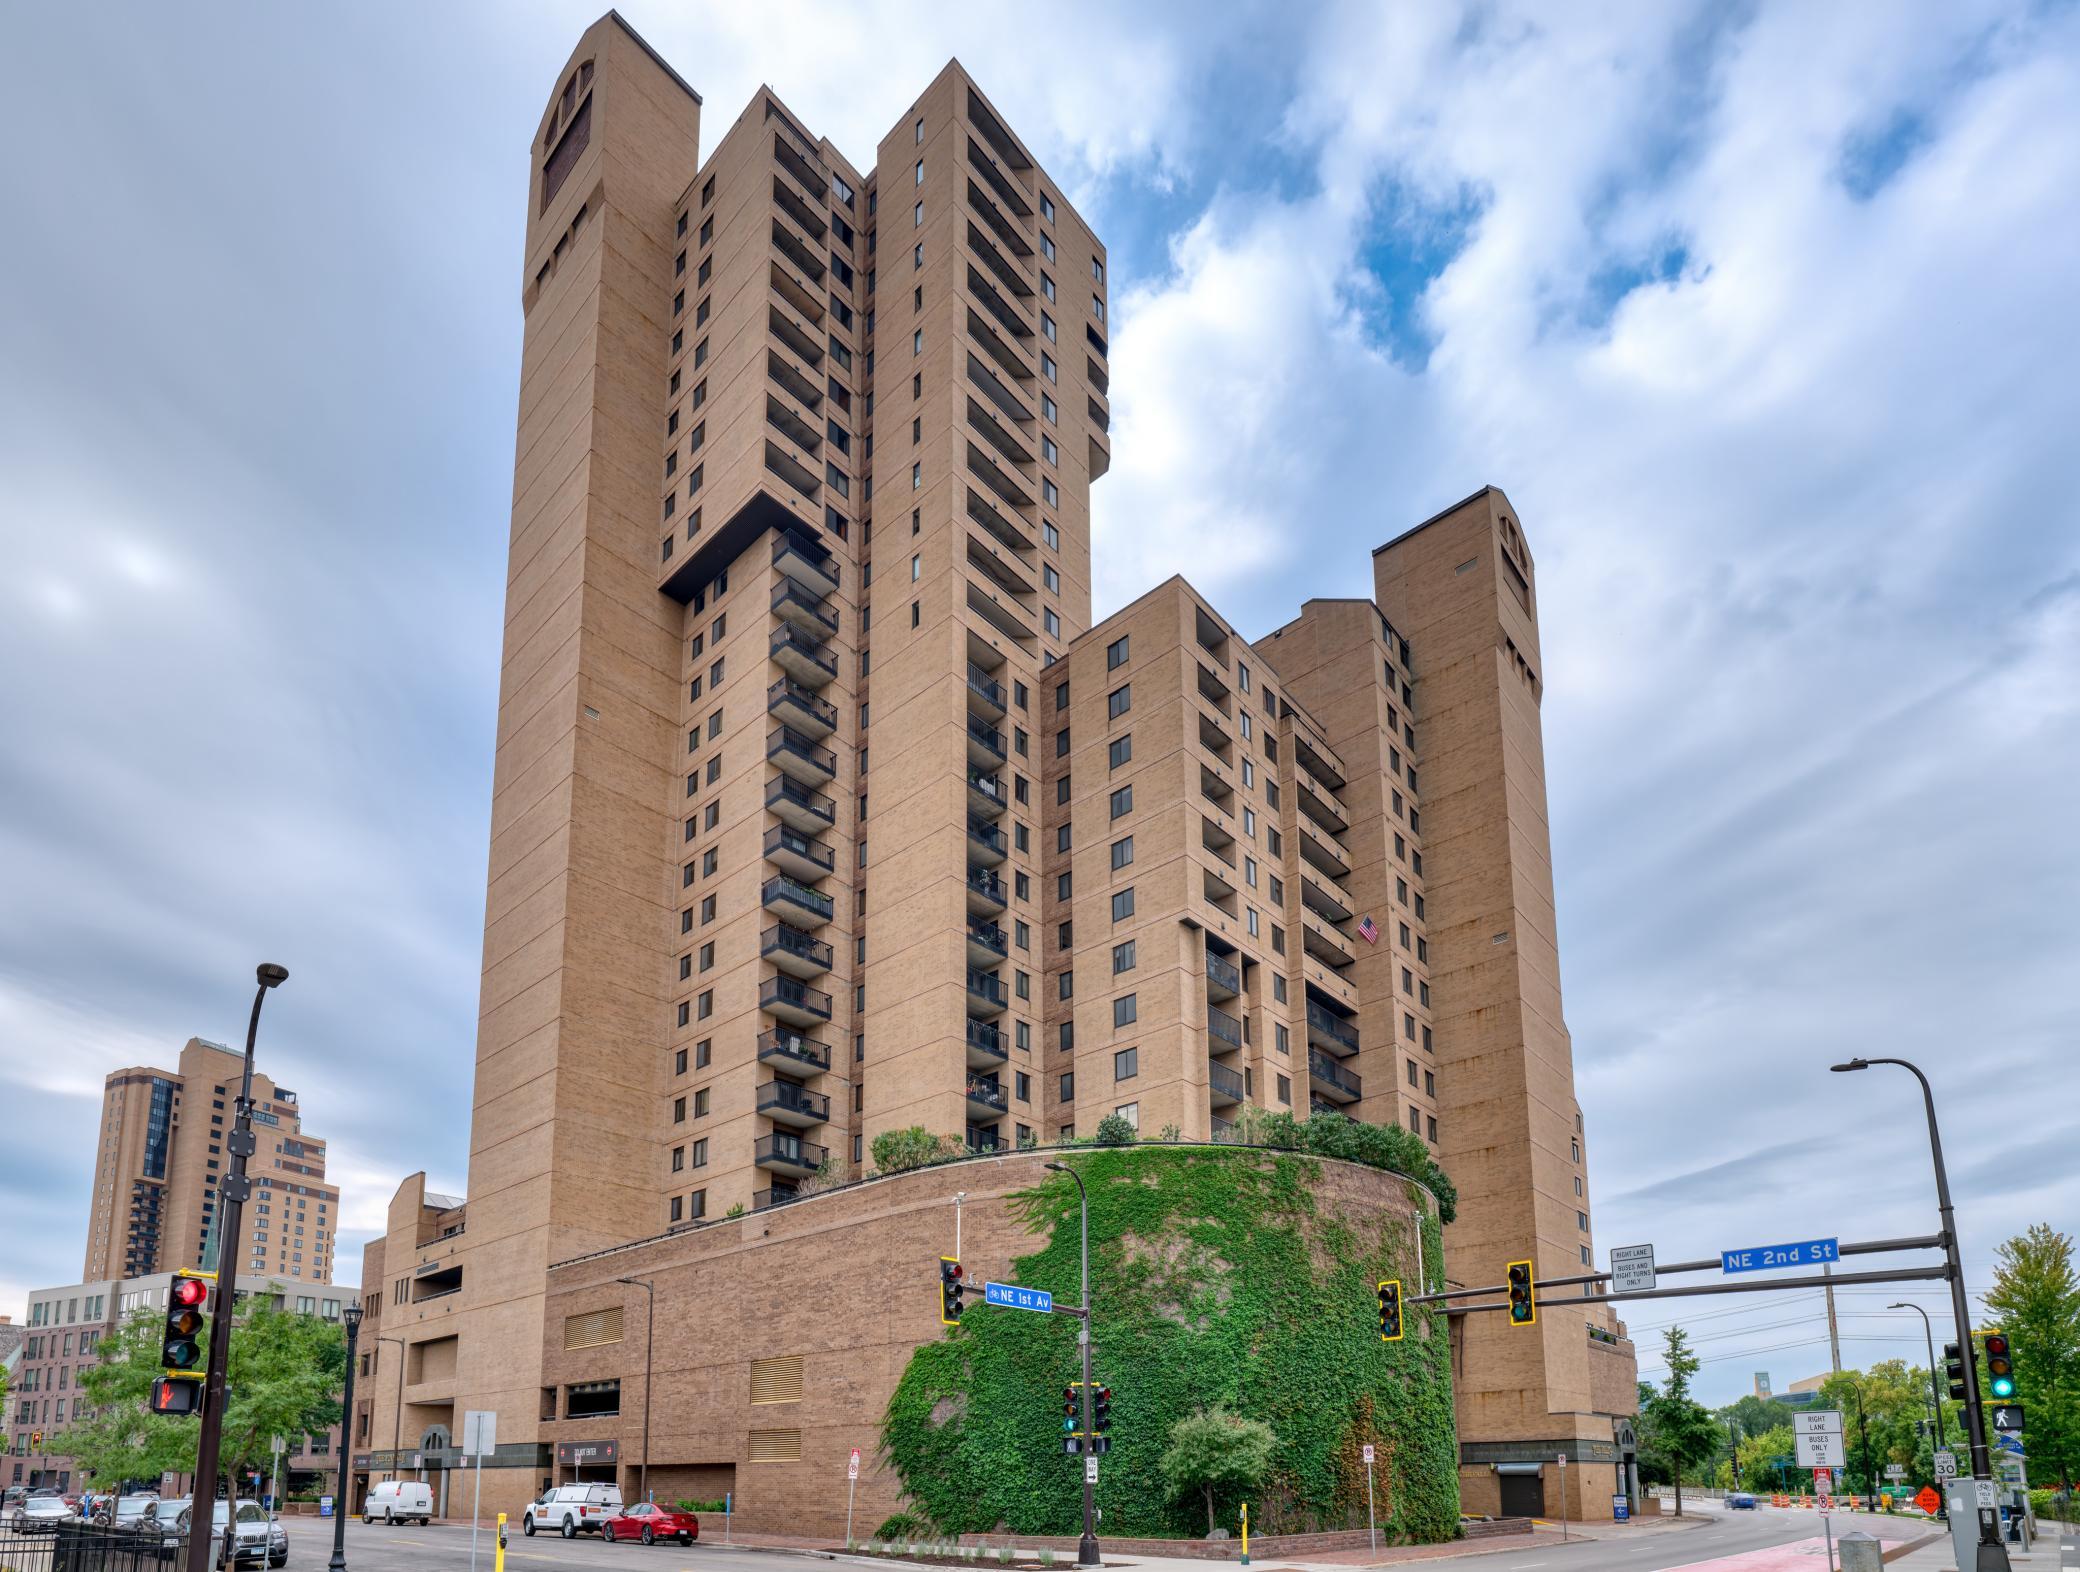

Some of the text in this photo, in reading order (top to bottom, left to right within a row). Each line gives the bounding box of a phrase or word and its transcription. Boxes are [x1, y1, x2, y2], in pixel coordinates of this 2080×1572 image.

[1616, 1248, 1648, 1258] RIGHT LANE
[1728, 1244, 1831, 1268] NE 2nd St
[1618, 1263, 1635, 1271] BUSES
[1001, 1289, 1048, 1308] NE 1st Av
[1938, 1465, 1954, 1474] 30
